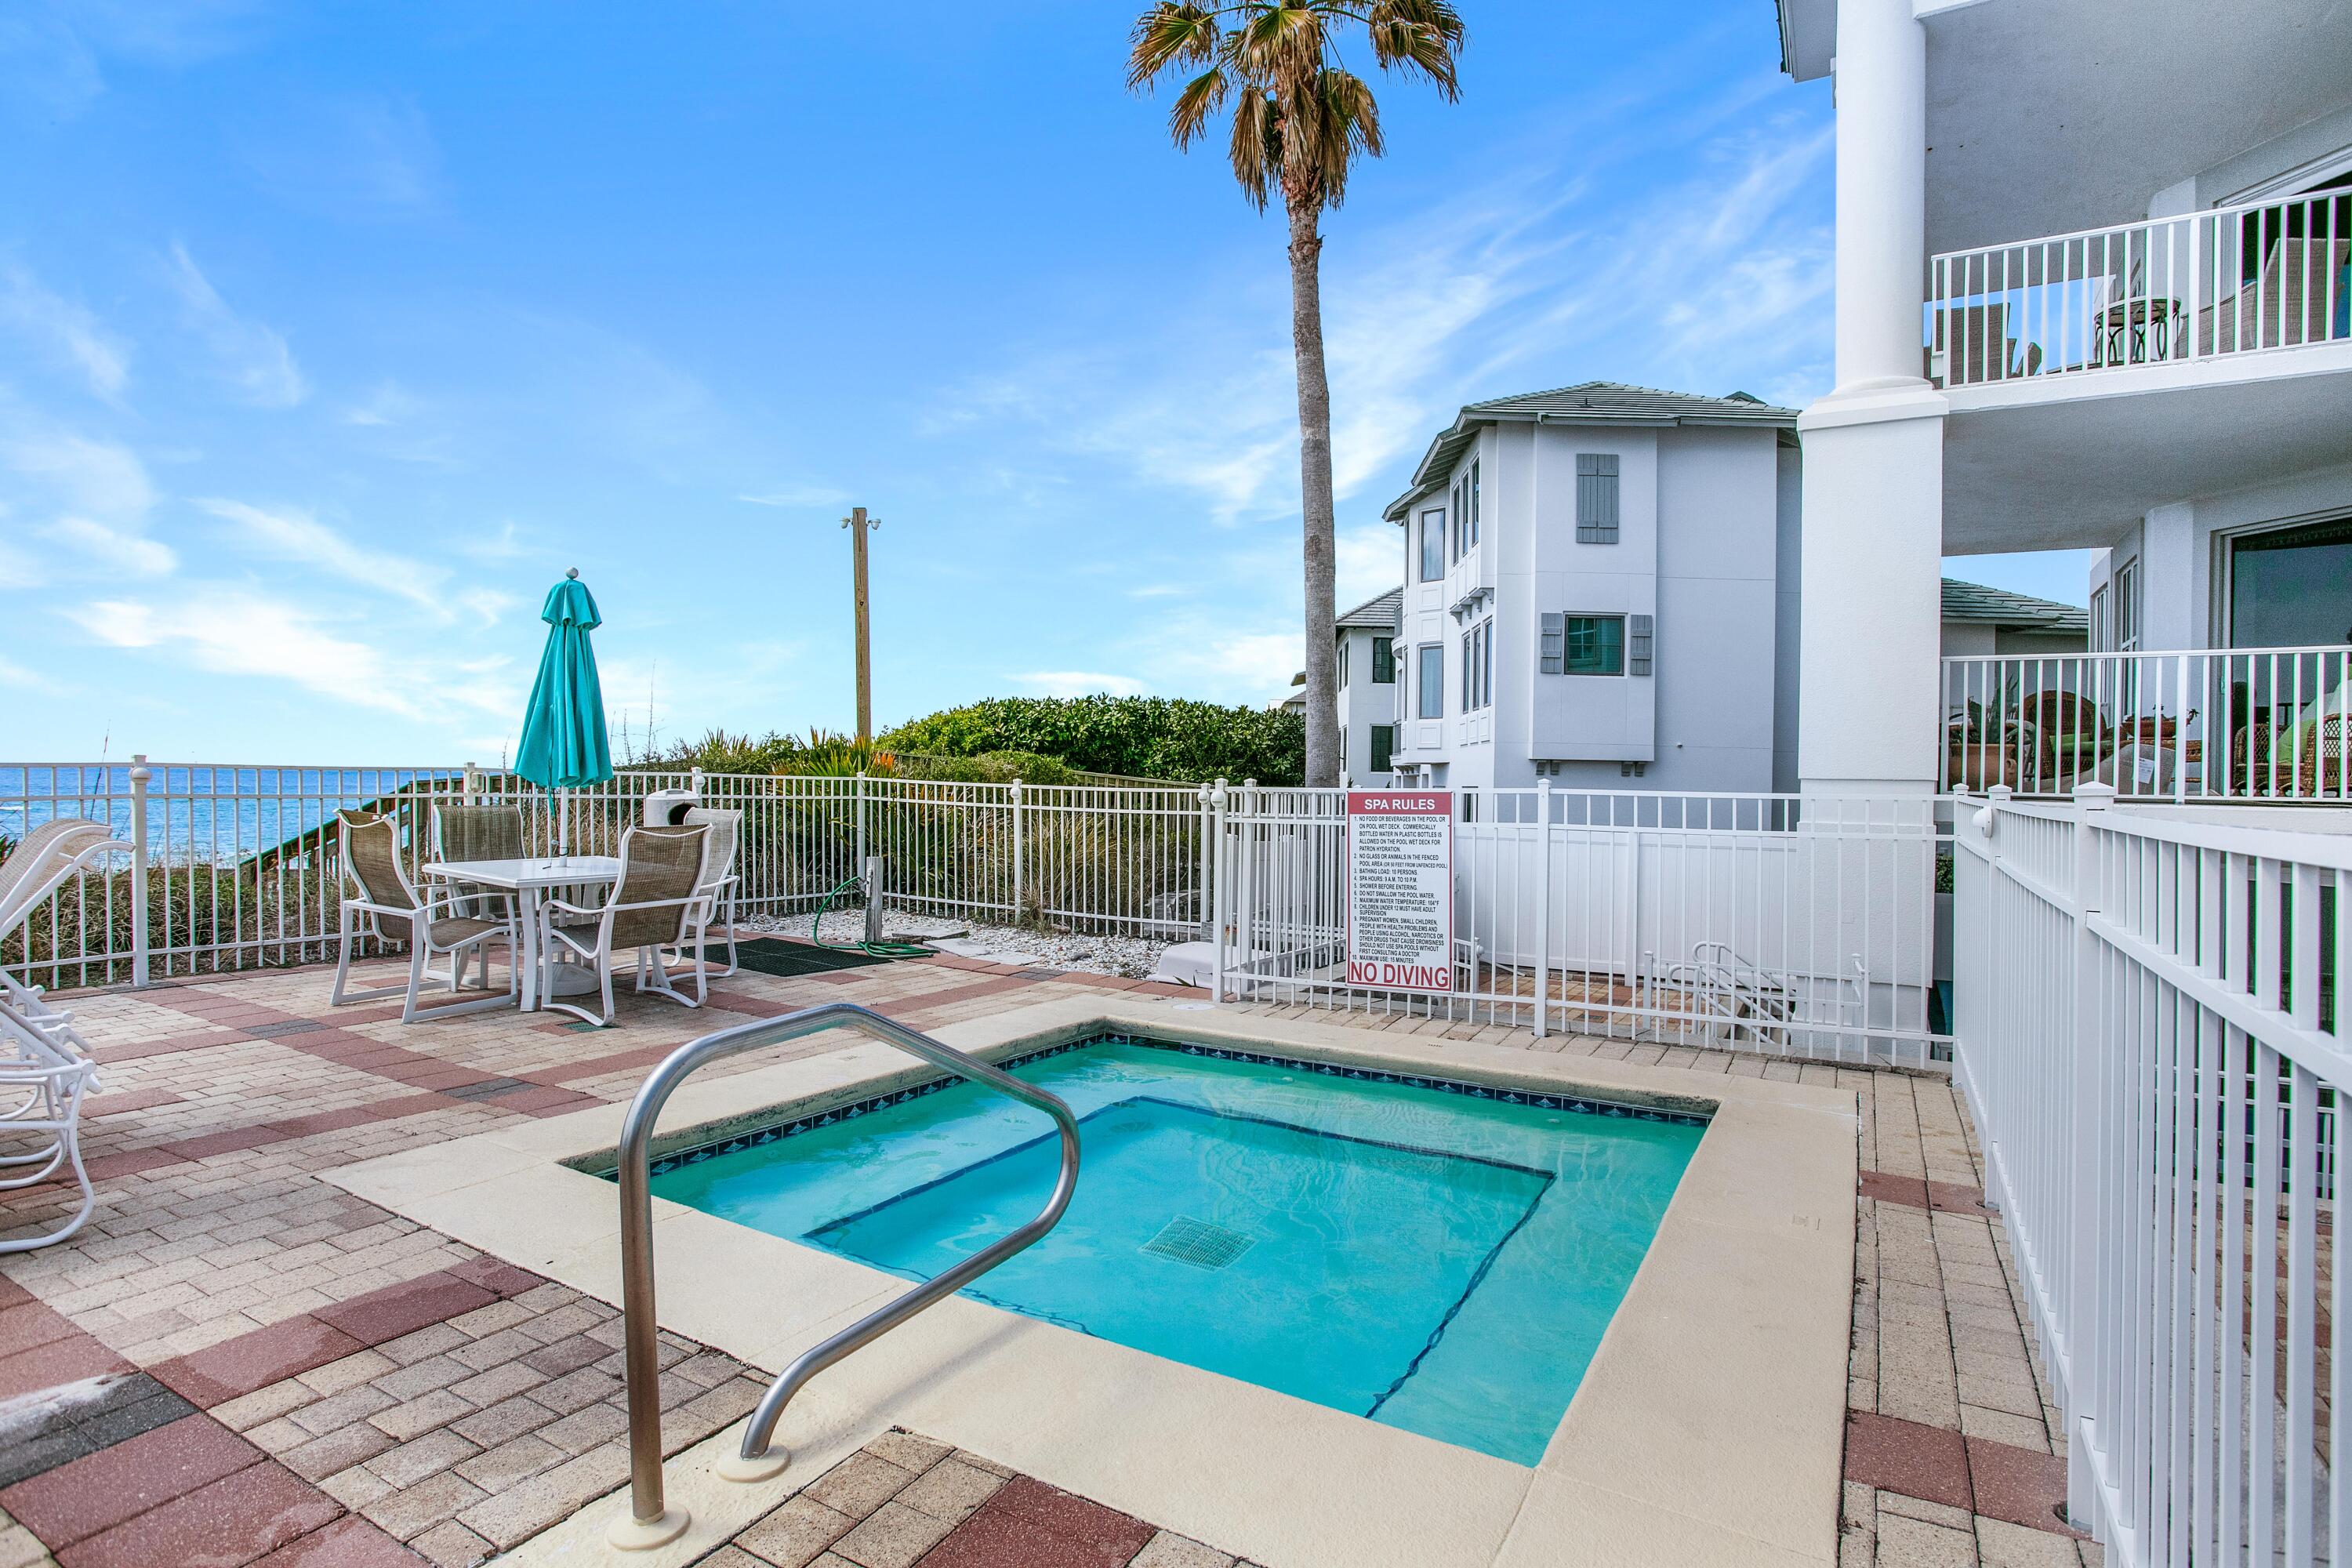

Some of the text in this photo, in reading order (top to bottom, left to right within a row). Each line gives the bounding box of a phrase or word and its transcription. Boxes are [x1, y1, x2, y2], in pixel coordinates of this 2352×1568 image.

[1364, 799, 1436, 810] SPA RULES
[1351, 961, 1449, 988] NO DIVING
